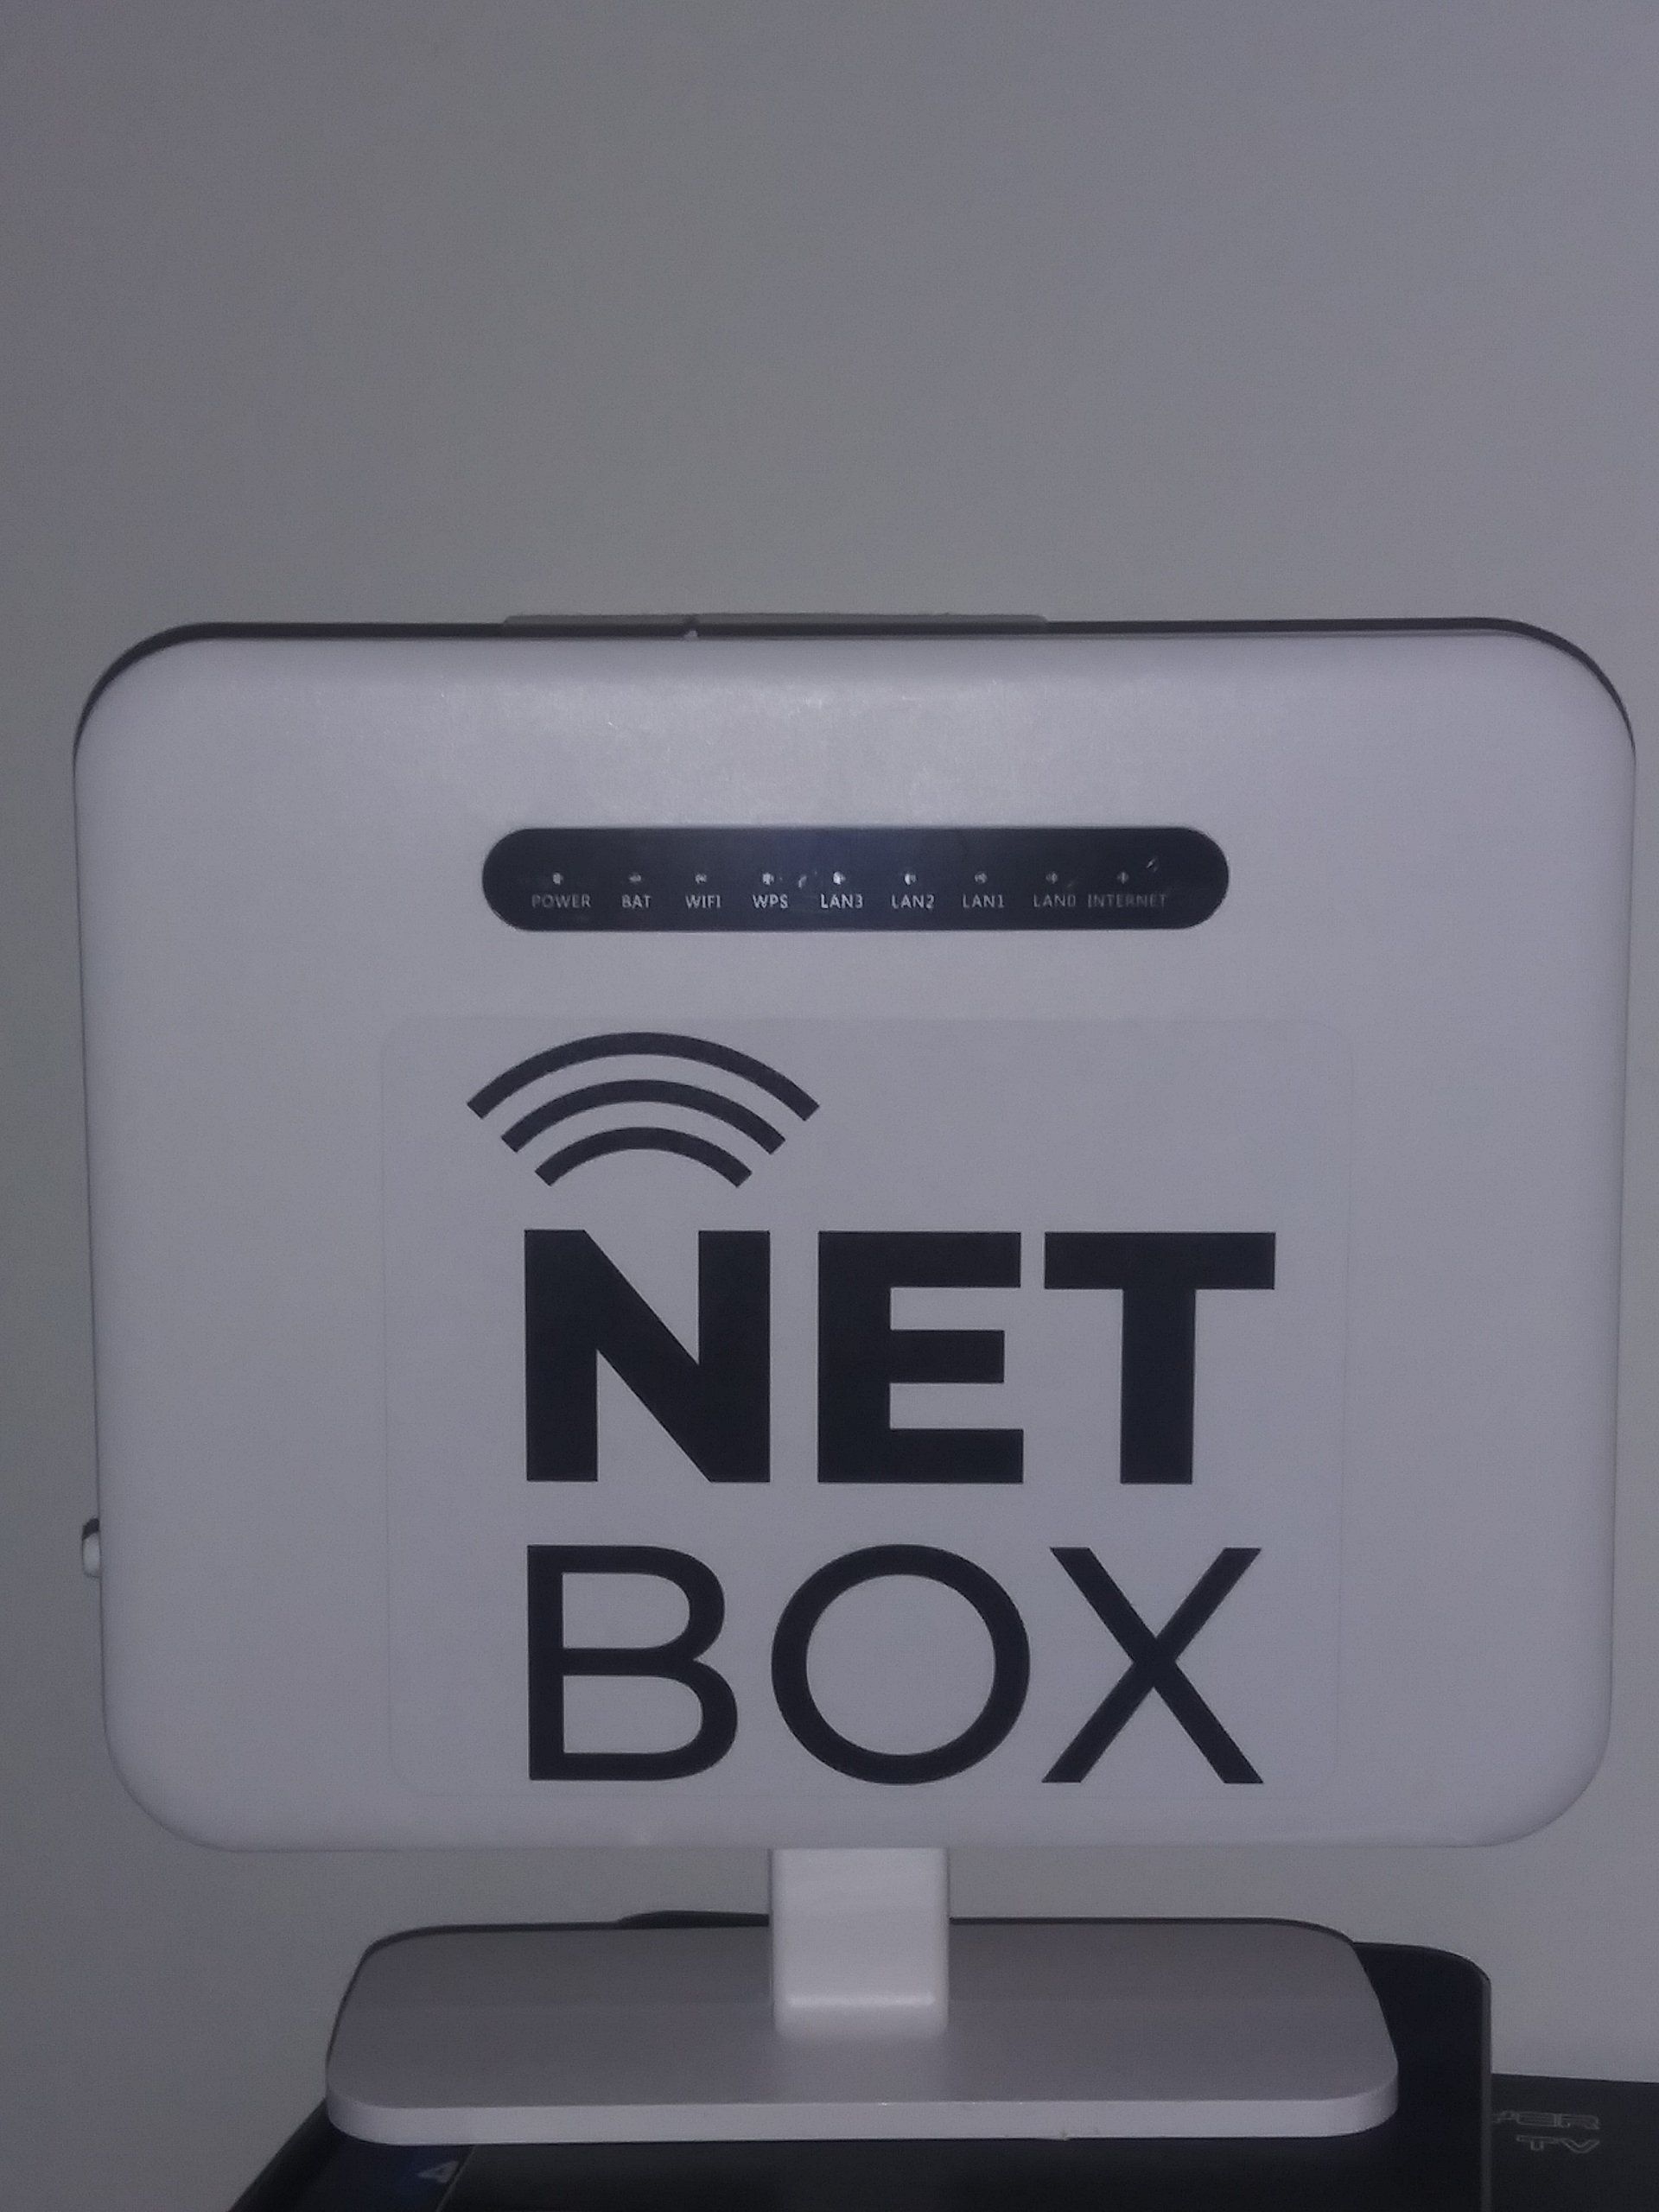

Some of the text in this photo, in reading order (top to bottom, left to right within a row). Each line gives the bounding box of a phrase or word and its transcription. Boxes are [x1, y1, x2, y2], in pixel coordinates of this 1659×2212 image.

[531, 893, 1168, 910] POWER BAT WIFI WPS LAN3 LAN2 LAN1 LAN0 INTERNET
[524, 1230, 1275, 1484] NET
[527, 1543, 1264, 1785] BOX
